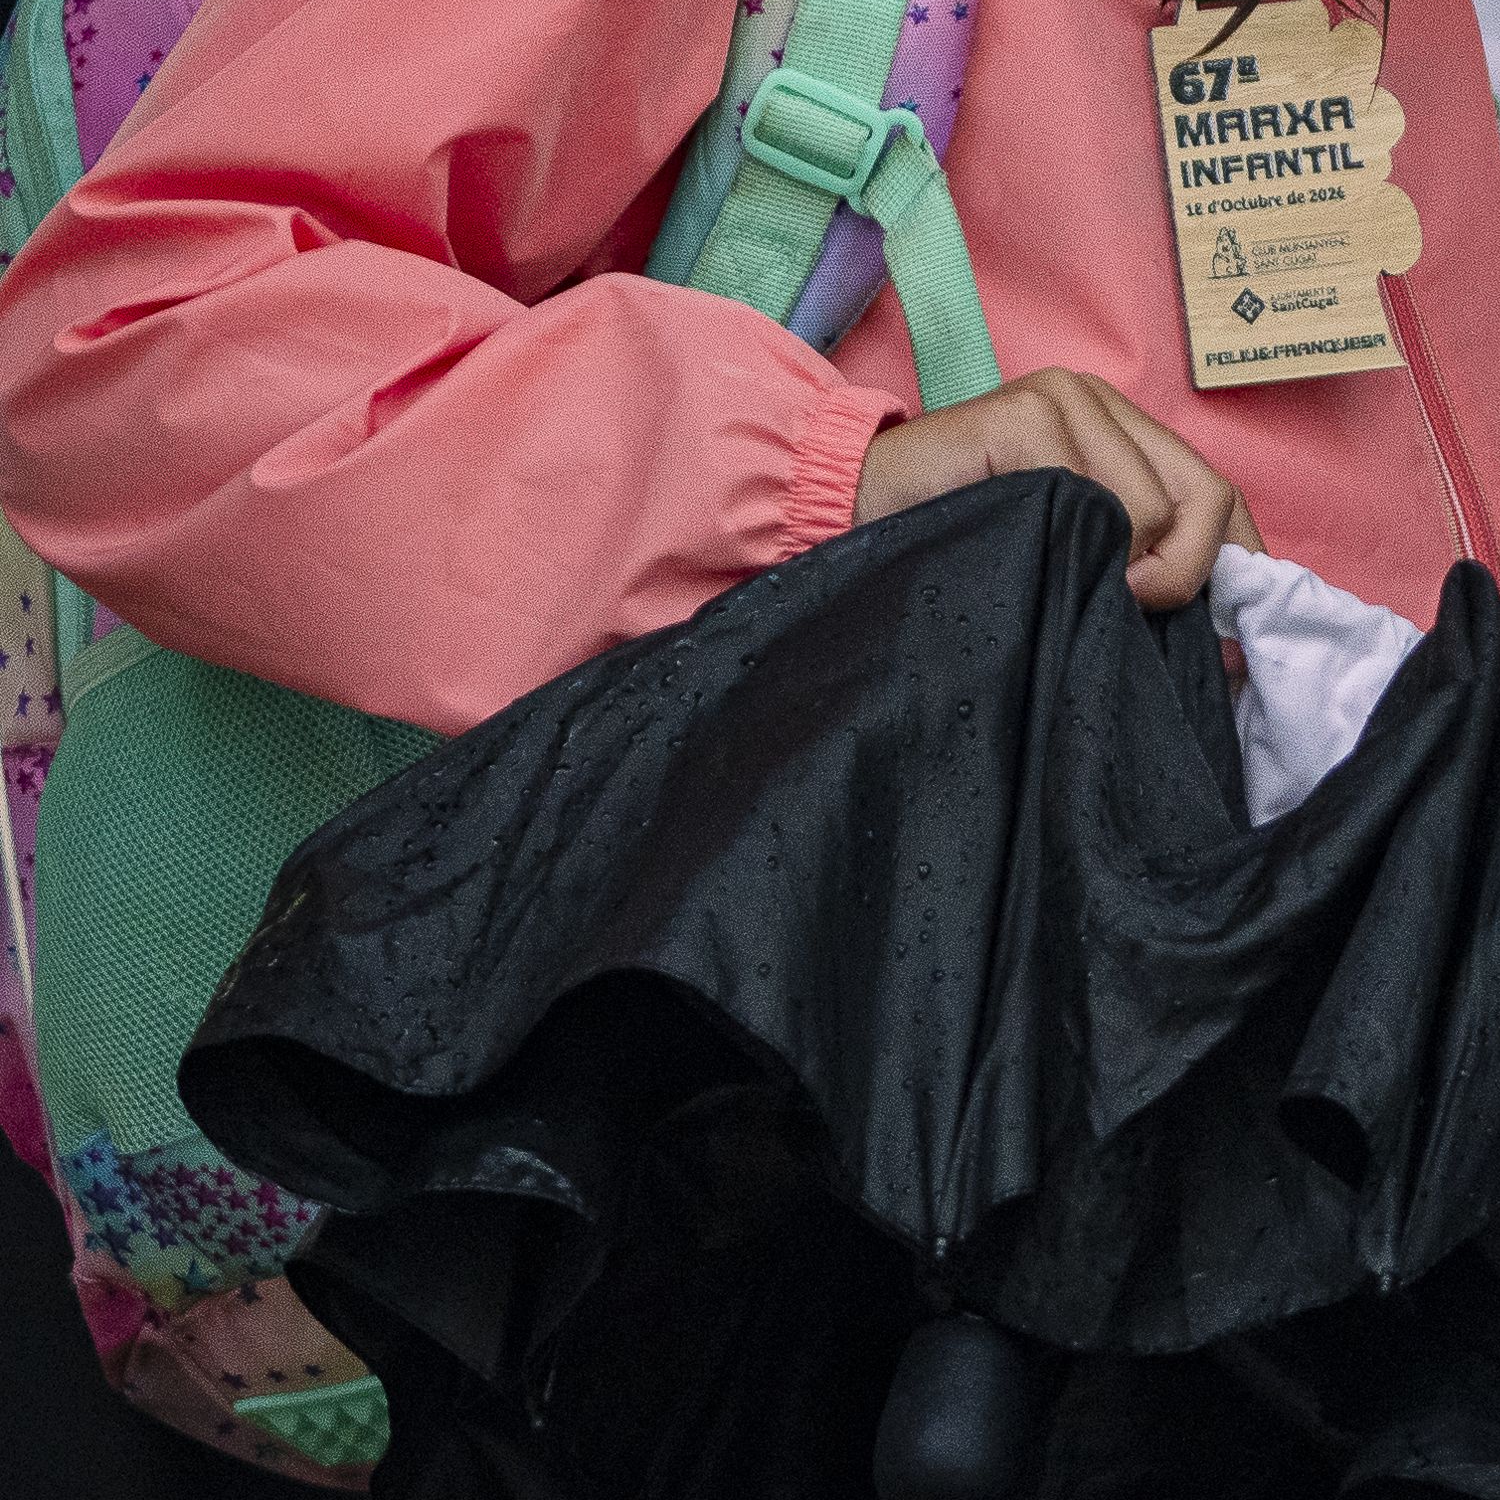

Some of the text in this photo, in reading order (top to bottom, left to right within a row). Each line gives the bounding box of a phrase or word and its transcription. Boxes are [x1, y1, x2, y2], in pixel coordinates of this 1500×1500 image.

[1179, 143, 1365, 189] INFANTIL
[1207, 193, 1283, 215] d'Octubre
[1287, 189, 1306, 205] de
[1251, 243, 1277, 257] CLUB
[1253, 253, 1318, 270] SANT CUGAT
[1271, 295, 1340, 313] SantCugat
